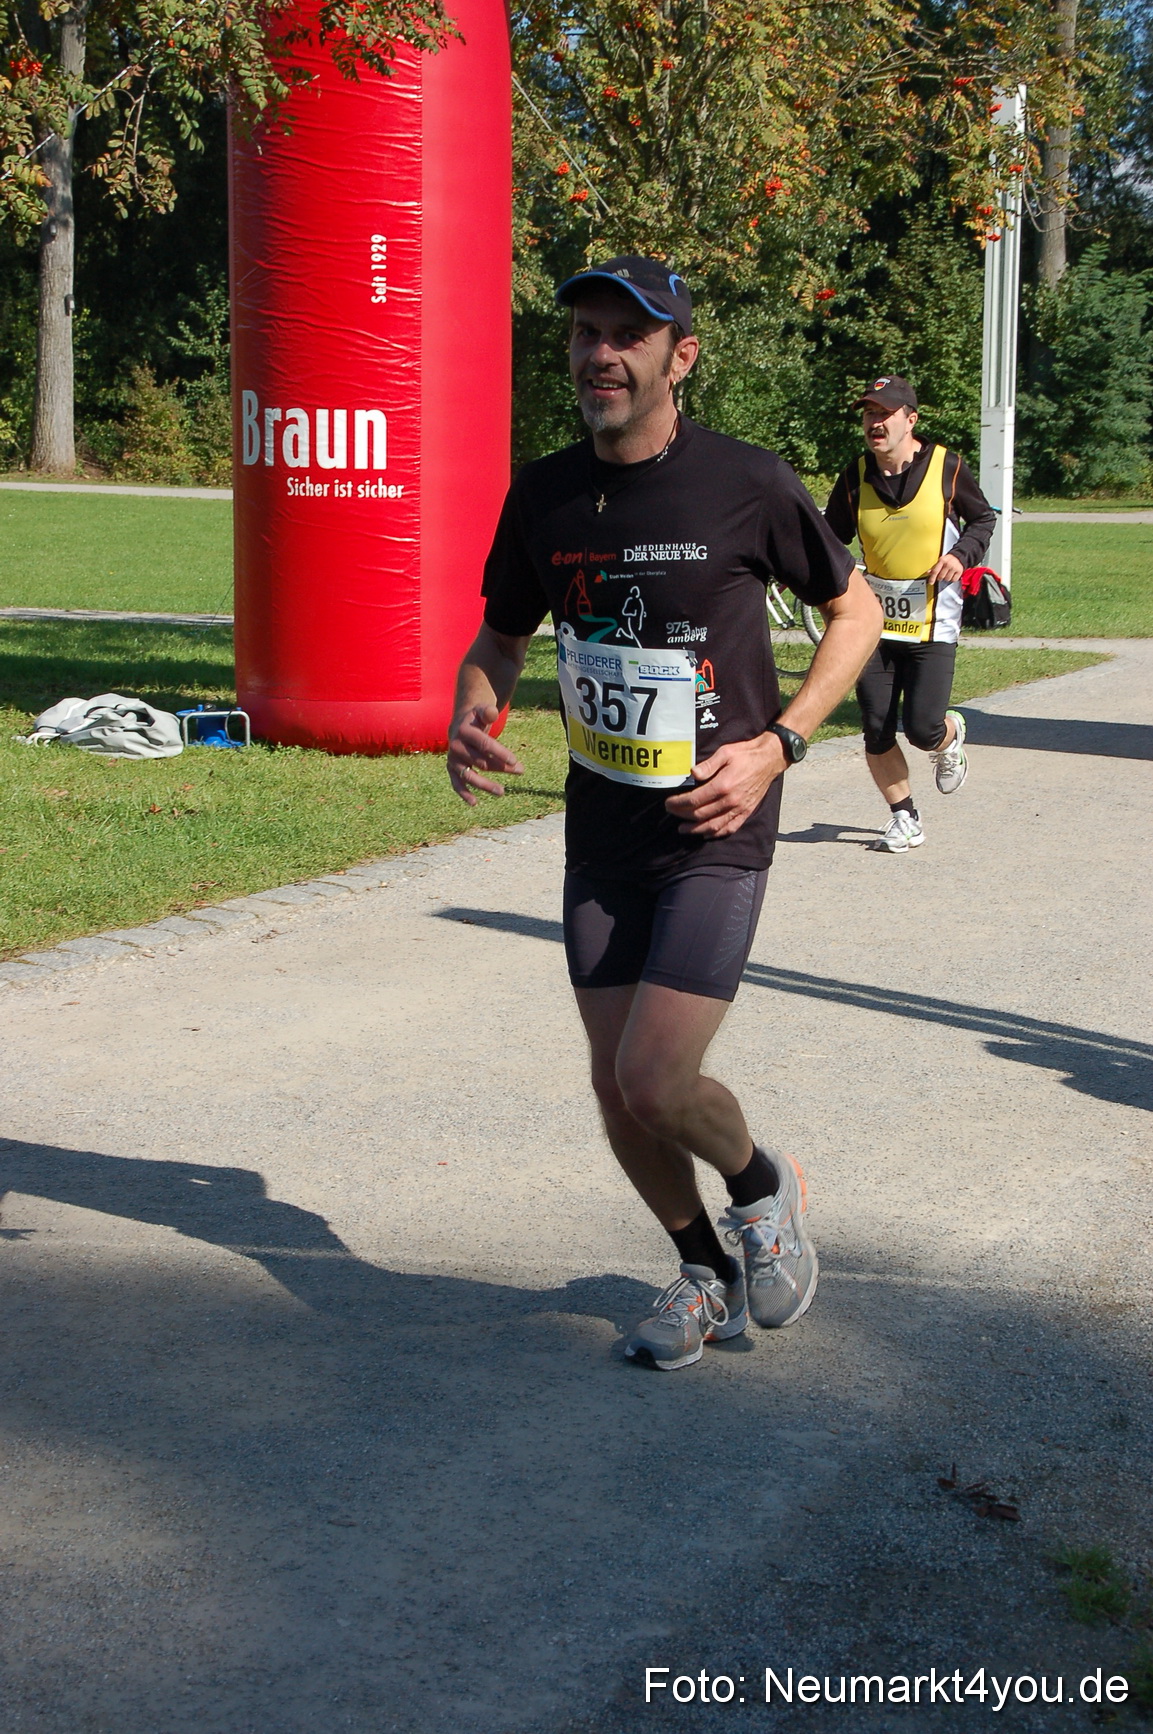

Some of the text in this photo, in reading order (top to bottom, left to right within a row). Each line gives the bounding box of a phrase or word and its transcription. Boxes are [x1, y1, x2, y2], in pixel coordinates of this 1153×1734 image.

[371, 234, 387, 304] Seit 1929
[242, 390, 387, 470] Braun
[286, 475, 404, 499] Sicher ist sicher
[589, 552, 617, 562] Bayern
[623, 545, 708, 563] DER NEUE TAG
[634, 543, 697, 552] MEDIENHAUS
[665, 620, 690, 635] 975
[667, 631, 708, 644] amberg
[566, 648, 623, 671] PFLEIDERER
[575, 676, 658, 736] 357
[582, 725, 663, 769] Werner
